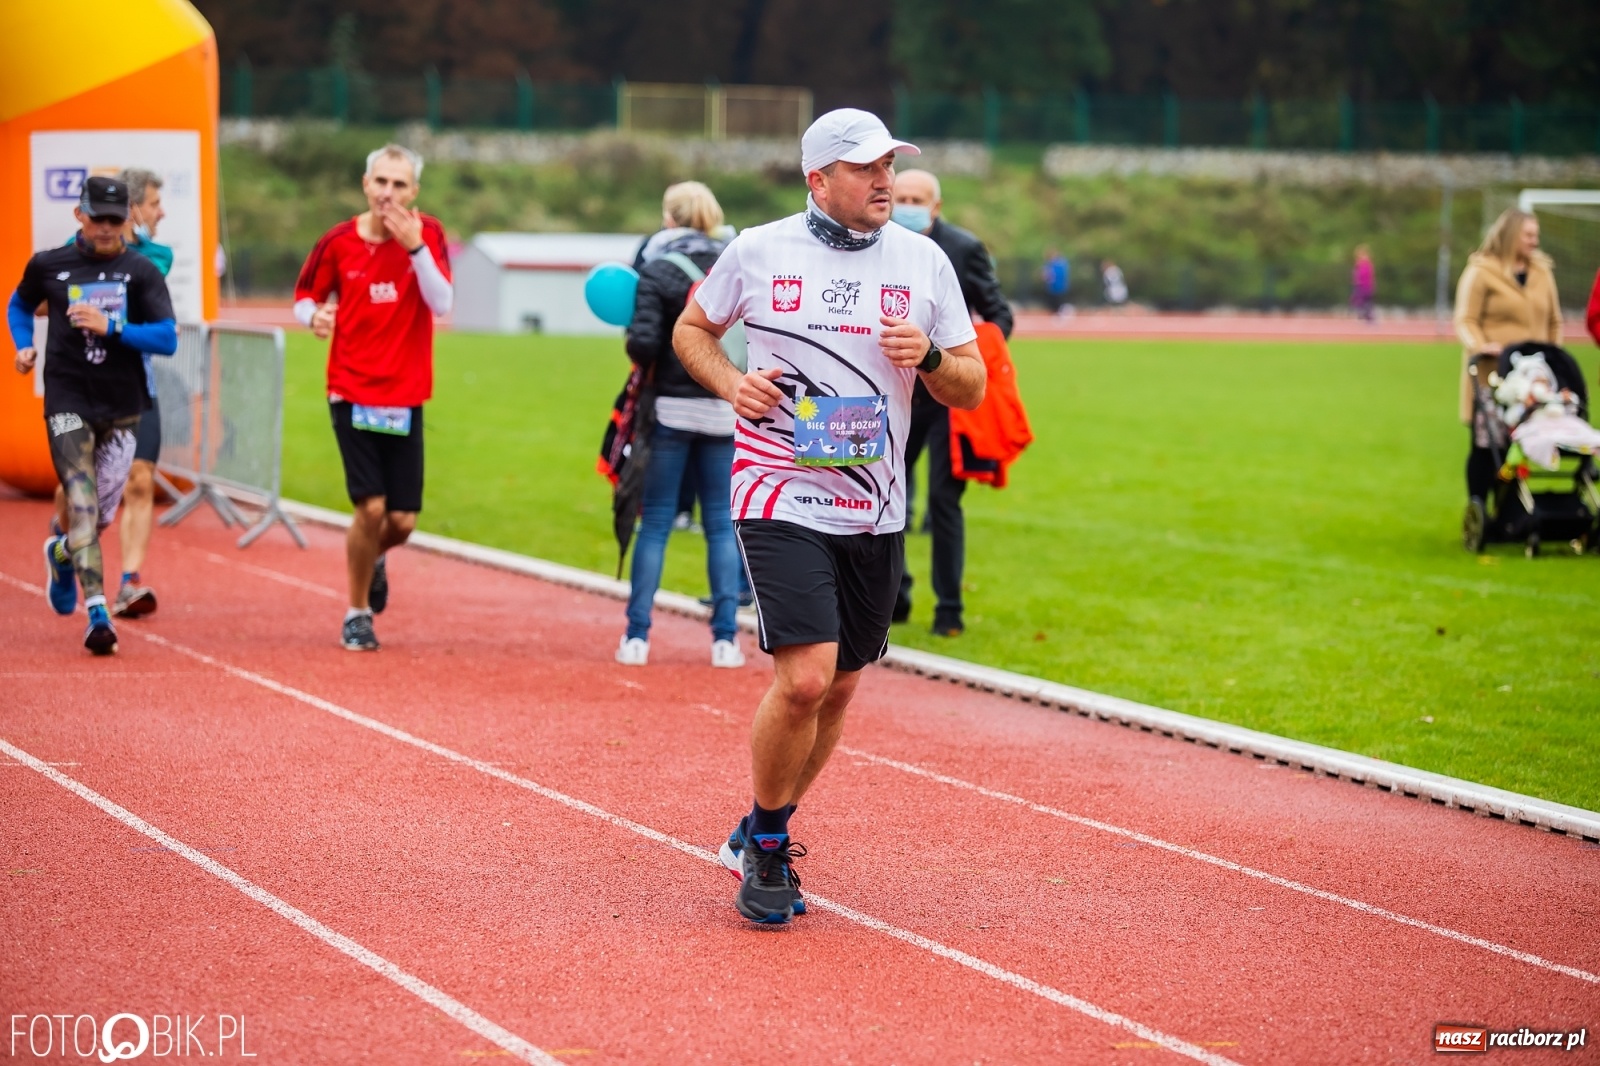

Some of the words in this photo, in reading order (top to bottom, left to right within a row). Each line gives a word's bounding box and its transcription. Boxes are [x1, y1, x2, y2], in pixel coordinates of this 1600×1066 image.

[821, 289, 860, 308] Gryf
[828, 306, 853, 316] Kietrz
[806, 421, 825, 430] BIEG
[830, 421, 846, 430] DLA
[848, 442, 878, 457] 057
